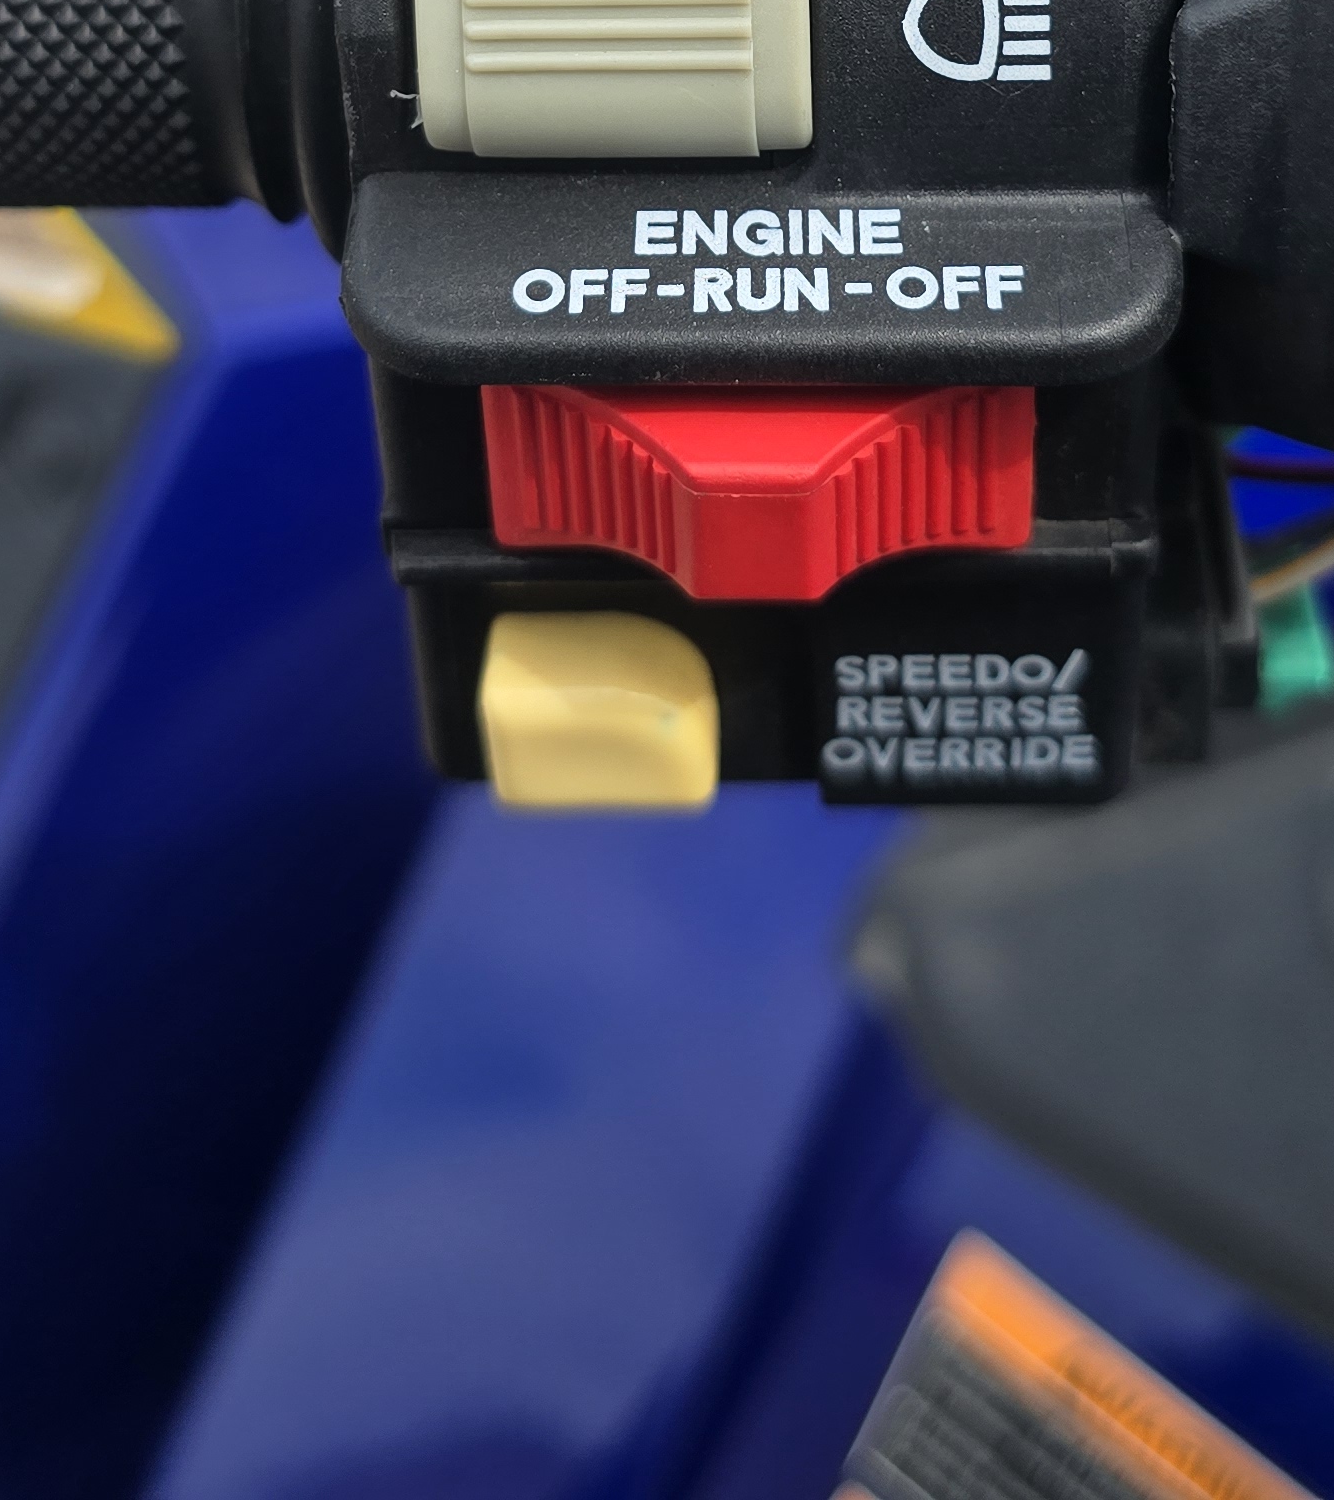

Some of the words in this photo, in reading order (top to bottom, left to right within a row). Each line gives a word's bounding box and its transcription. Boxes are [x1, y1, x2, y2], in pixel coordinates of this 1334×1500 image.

[633, 207, 904, 256] ENGINE
[833, 647, 1089, 694] SPEEDO/
[835, 694, 1084, 733] REVERSE
[821, 733, 1100, 777] OVERRIDE
